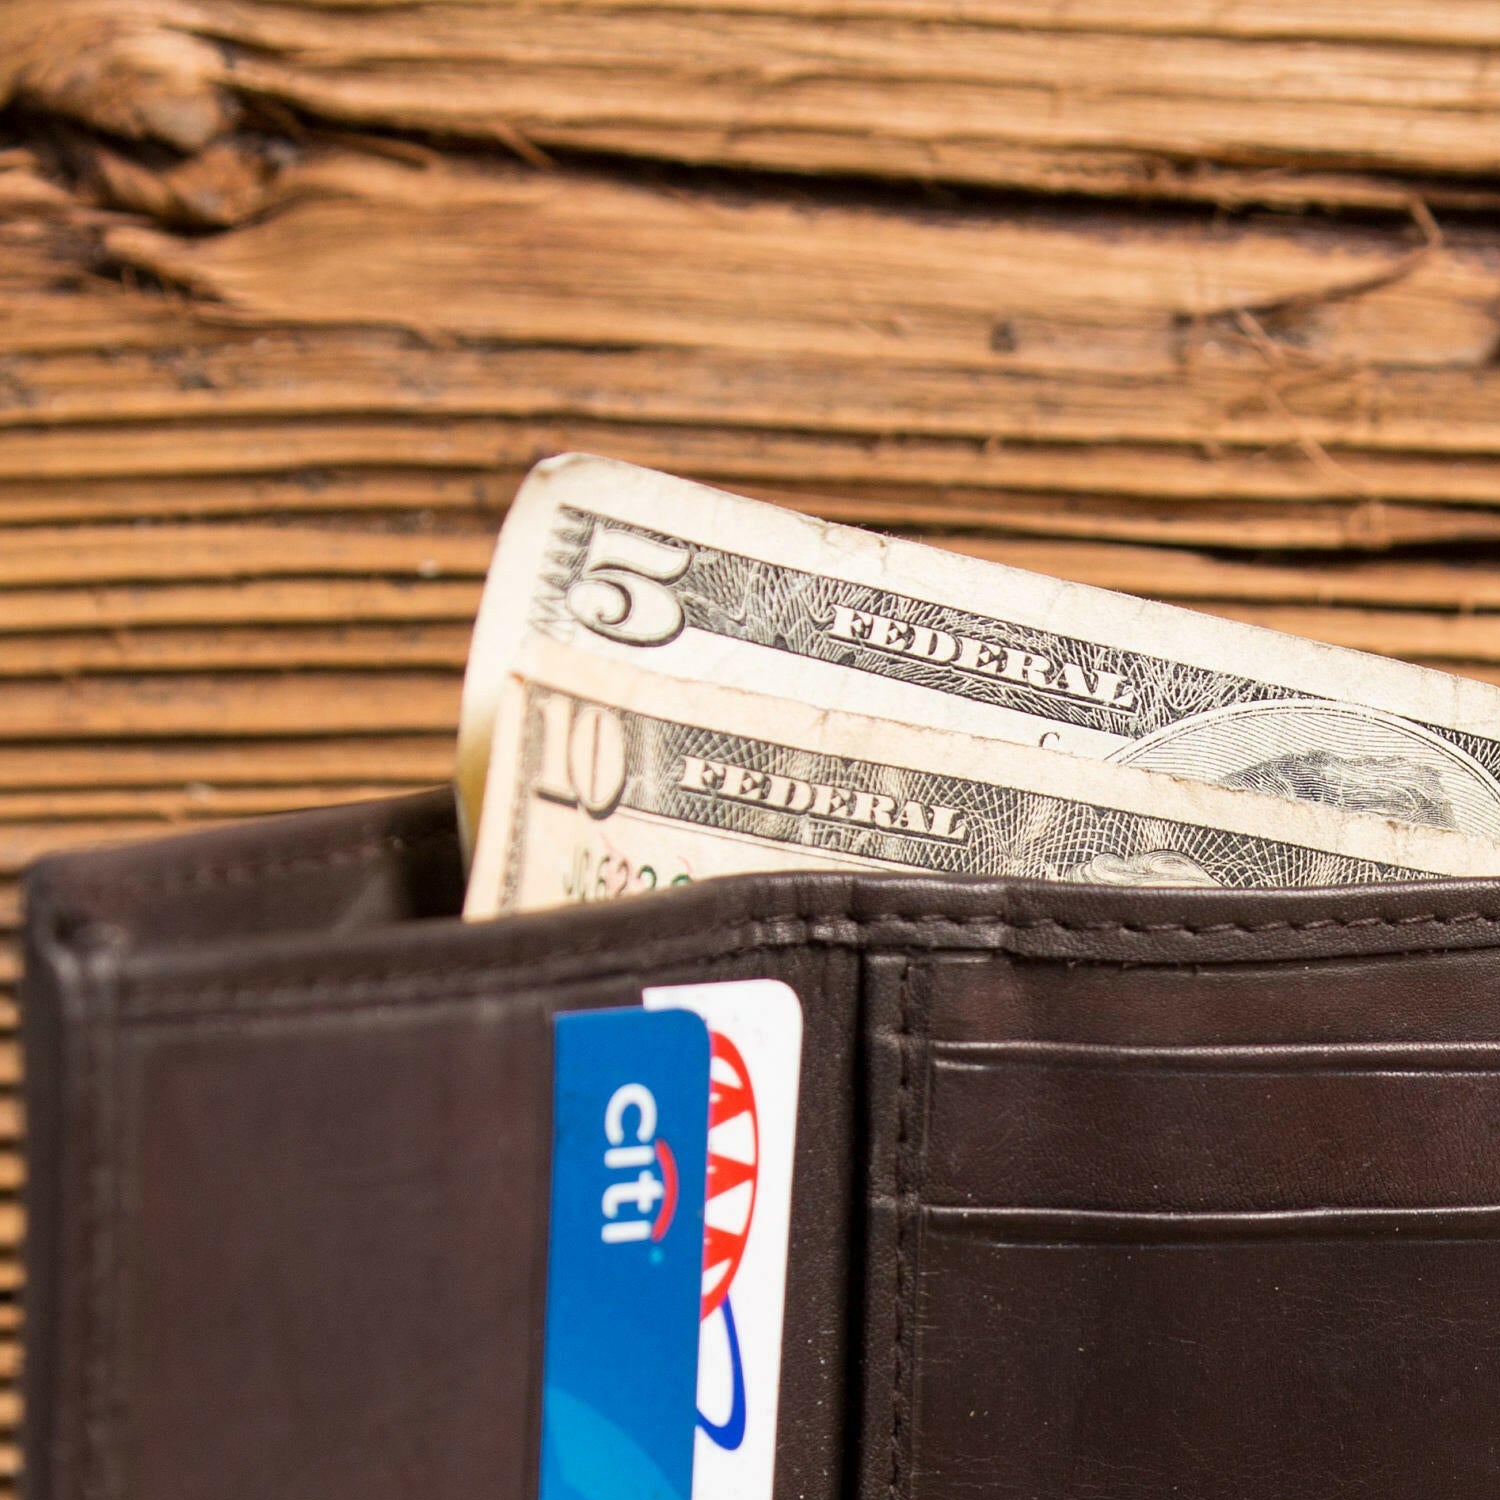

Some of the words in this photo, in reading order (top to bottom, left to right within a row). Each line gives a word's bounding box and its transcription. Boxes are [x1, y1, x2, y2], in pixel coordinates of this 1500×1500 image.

[566, 524, 692, 648] 5
[828, 603, 1137, 711] FEDERAL
[533, 693, 627, 821] 10
[680, 753, 967, 842] FEDERAL
[601, 1083, 679, 1244] citi
